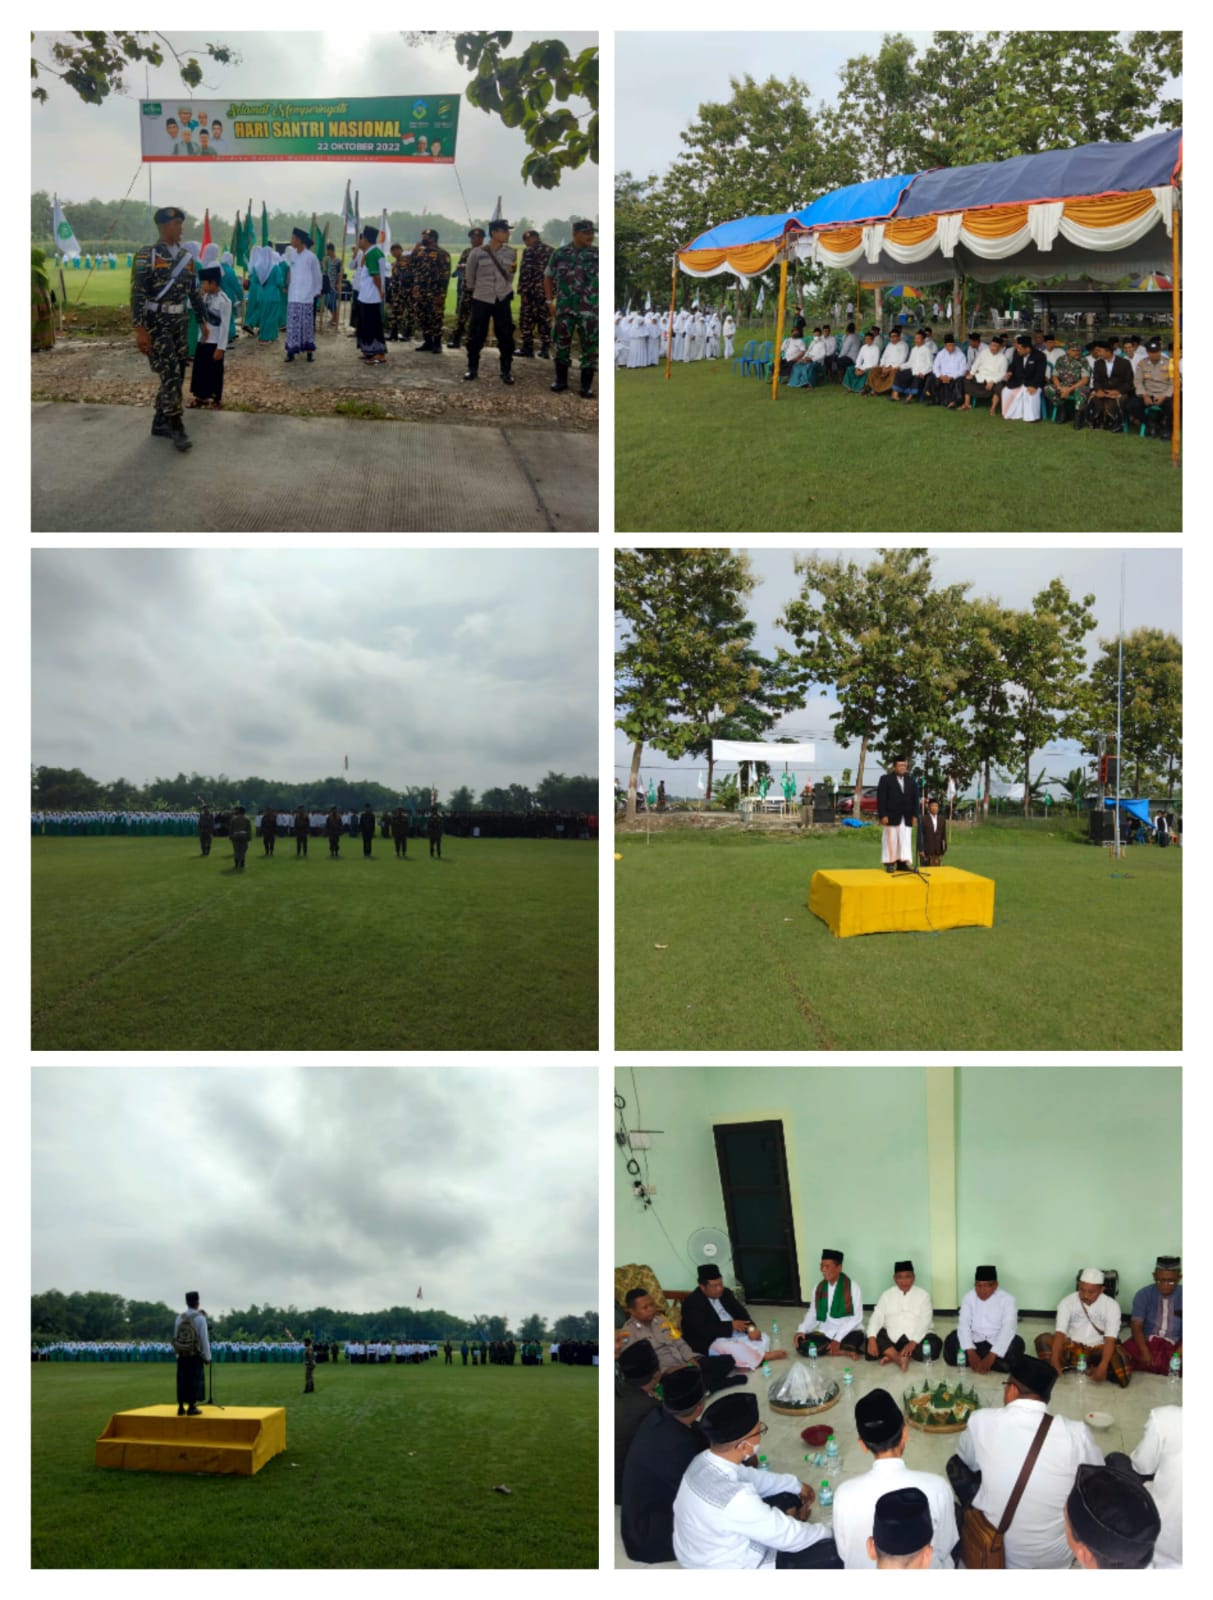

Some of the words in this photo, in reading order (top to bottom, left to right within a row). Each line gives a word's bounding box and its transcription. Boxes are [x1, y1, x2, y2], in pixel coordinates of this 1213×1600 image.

[227, 103, 272, 118] Selamat
[234, 120, 269, 138] HARI
[272, 120, 325, 138] SANTRI
[328, 120, 402, 138] NASIONAL
[317, 142, 329, 151] 22
[330, 142, 374, 151] OKTOBER
[376, 142, 400, 151] 2022
